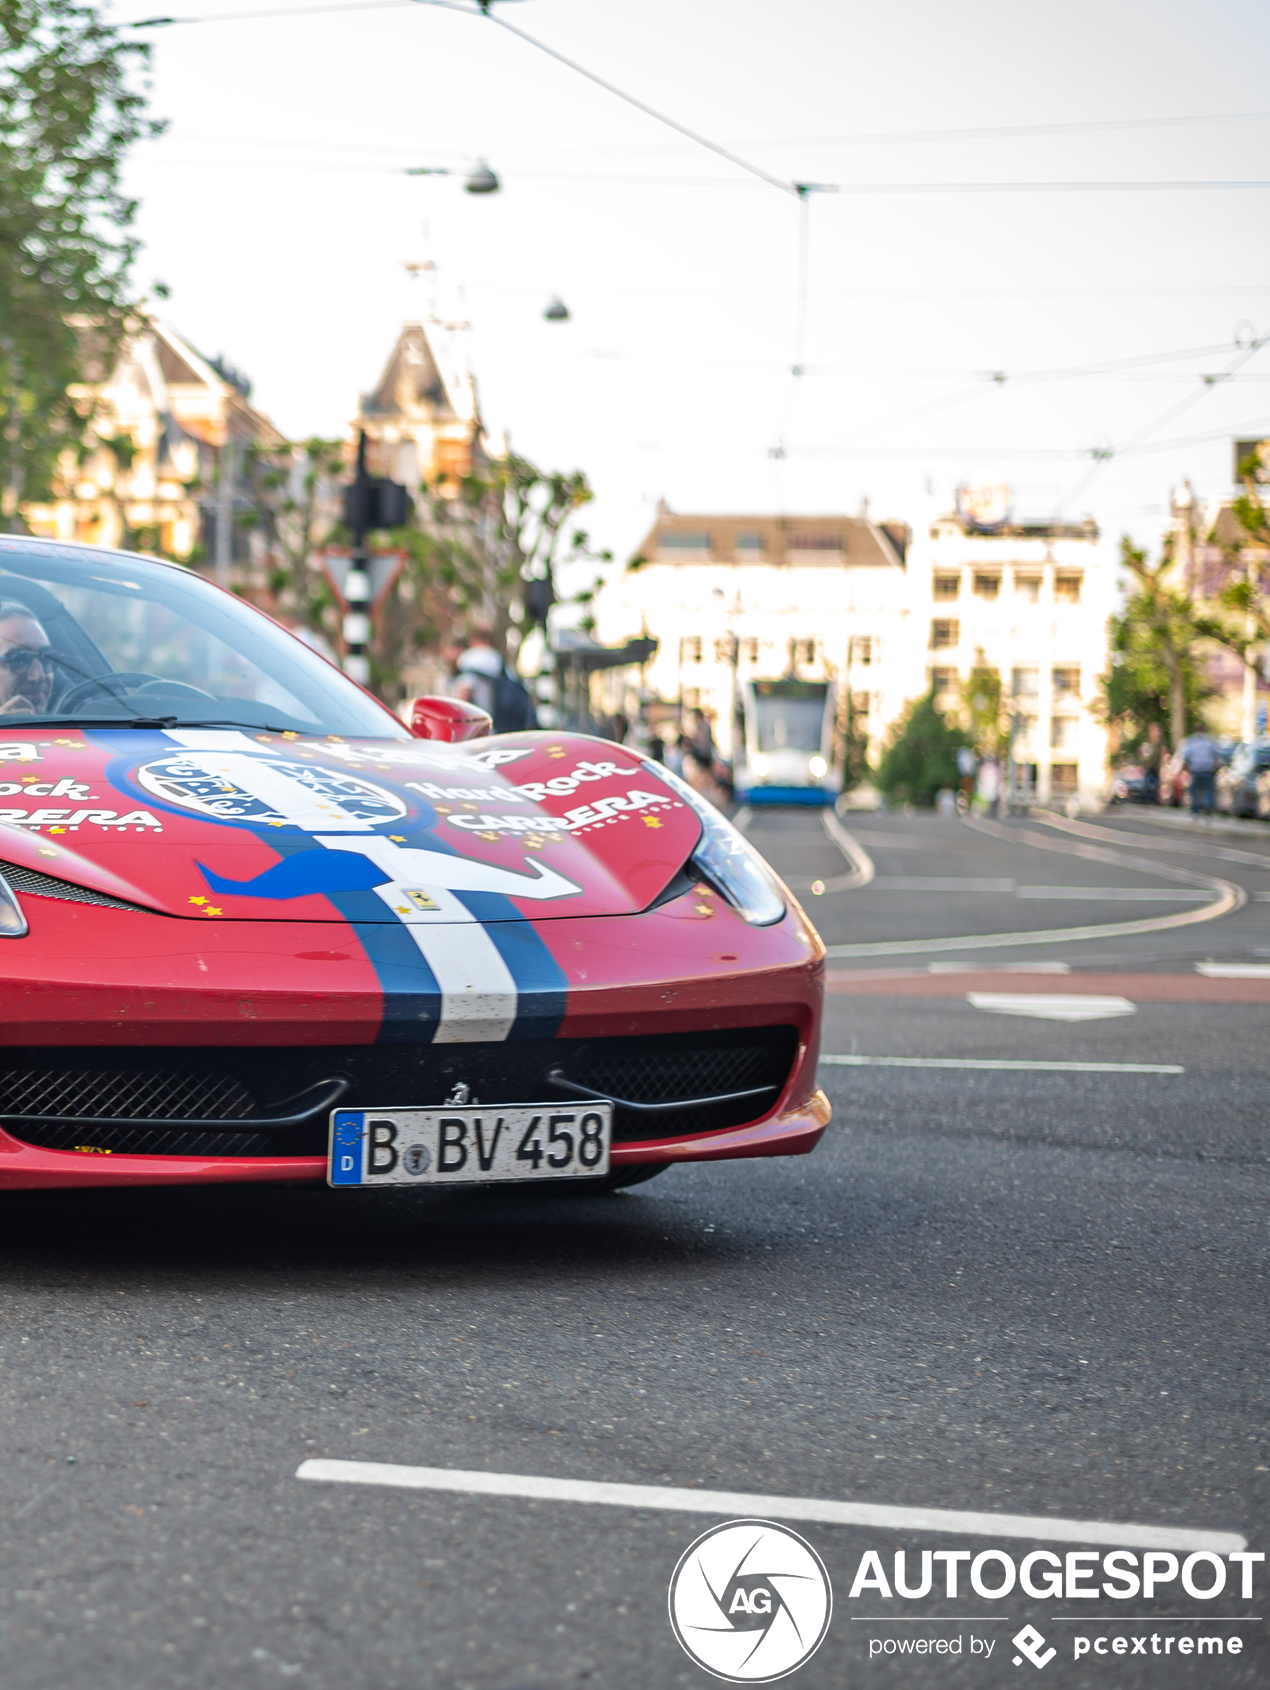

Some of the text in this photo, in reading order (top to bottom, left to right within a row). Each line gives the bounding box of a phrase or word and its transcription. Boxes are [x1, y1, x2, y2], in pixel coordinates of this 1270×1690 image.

[404, 761, 637, 802] Hard Rock
[446, 789, 672, 831] CARRERA
[341, 1156, 354, 1171] D
[367, 1112, 603, 1175] B BV 458
